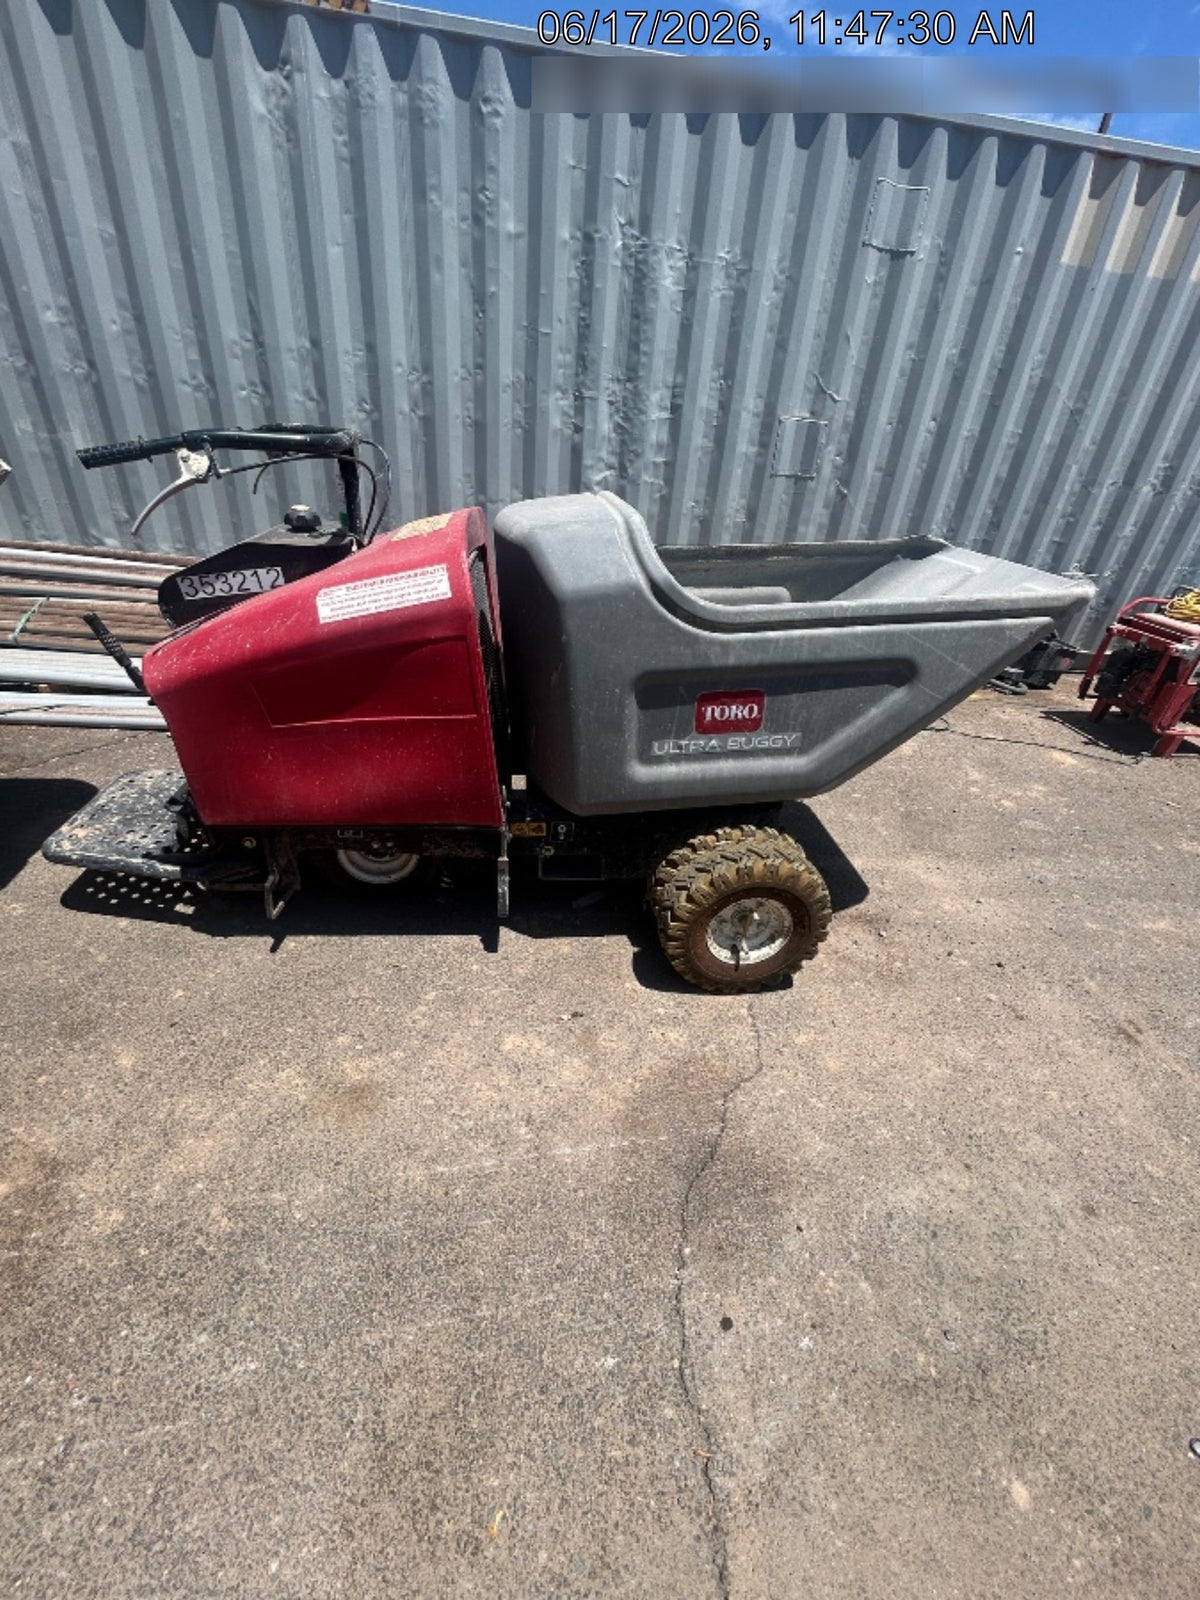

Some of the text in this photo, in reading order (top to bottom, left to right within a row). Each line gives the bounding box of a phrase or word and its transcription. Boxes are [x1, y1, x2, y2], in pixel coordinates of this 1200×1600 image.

[180, 567, 282, 598] 353212
[701, 703, 759, 721] TORO
[652, 735, 796, 755] ULTRA BUGGY
